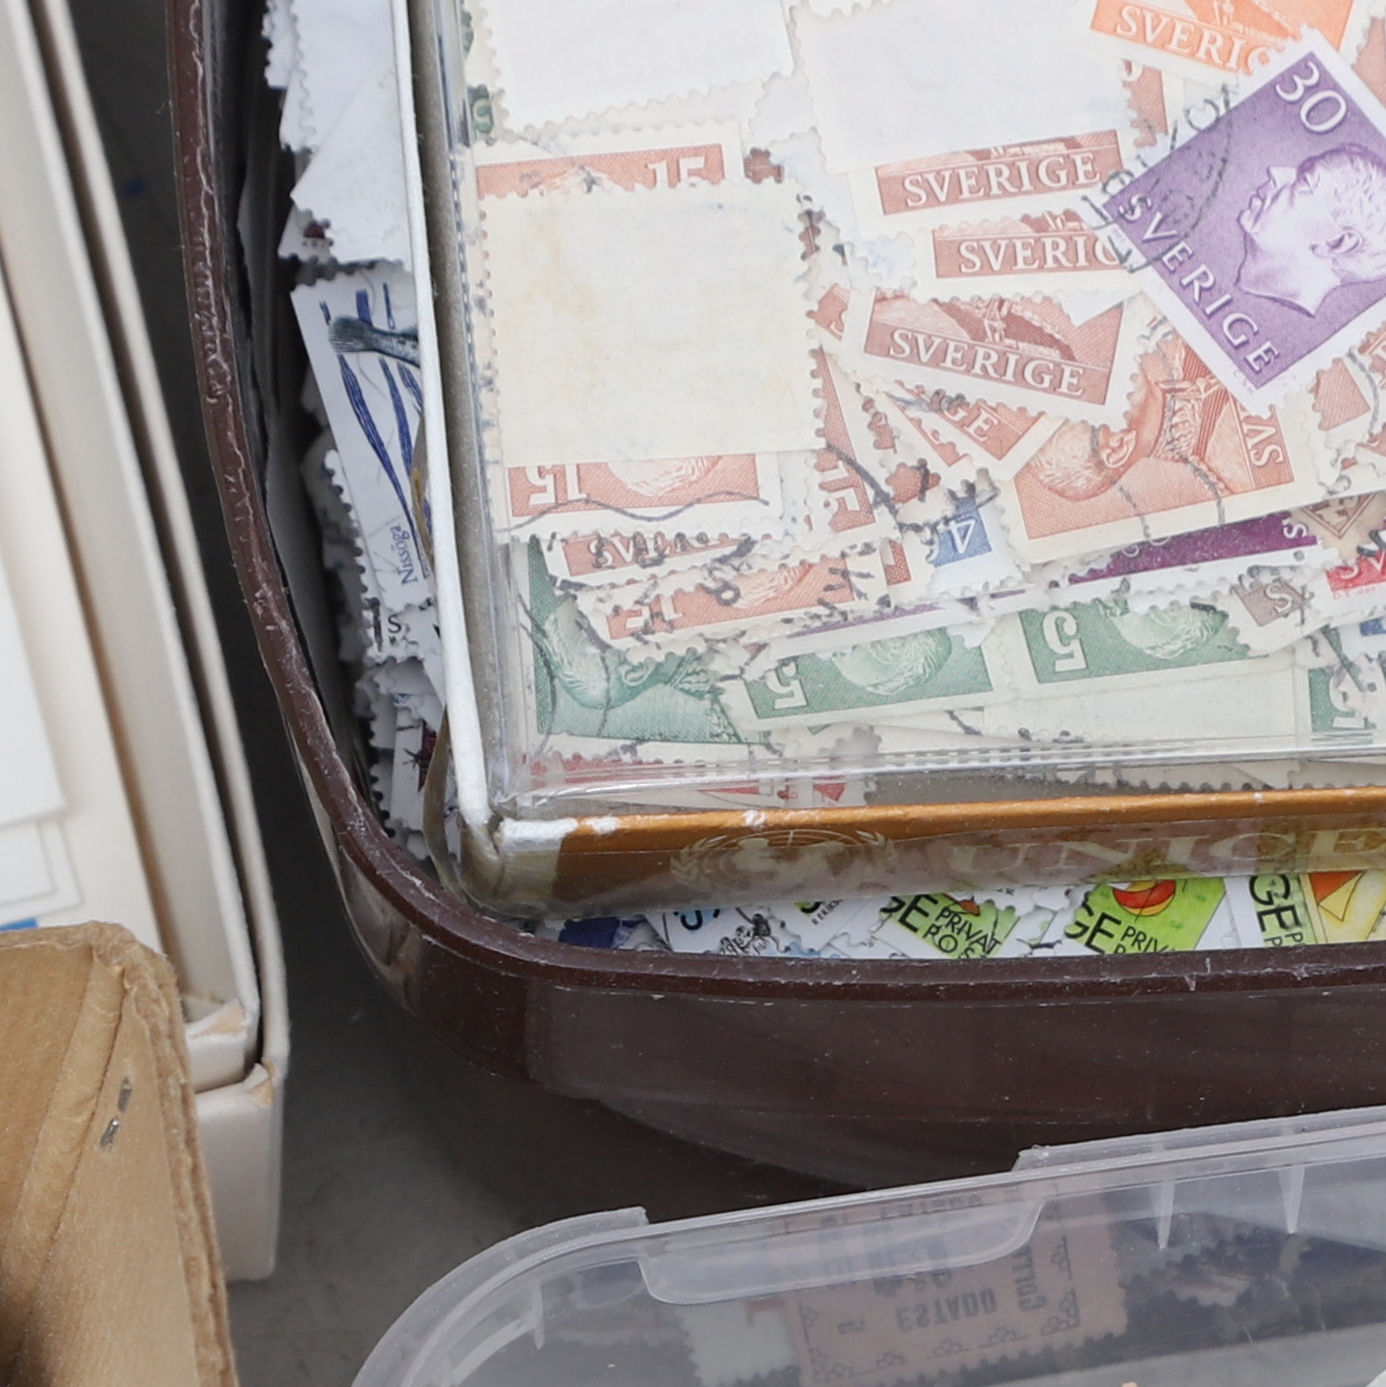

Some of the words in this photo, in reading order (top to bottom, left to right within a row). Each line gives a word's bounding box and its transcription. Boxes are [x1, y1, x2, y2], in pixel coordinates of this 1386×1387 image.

[1275, 60, 1348, 135] 30
[902, 152, 1102, 206] SVERIGE
[1118, 192, 1280, 375] SVERIGE
[889, 327, 1087, 398] SVERIGE
